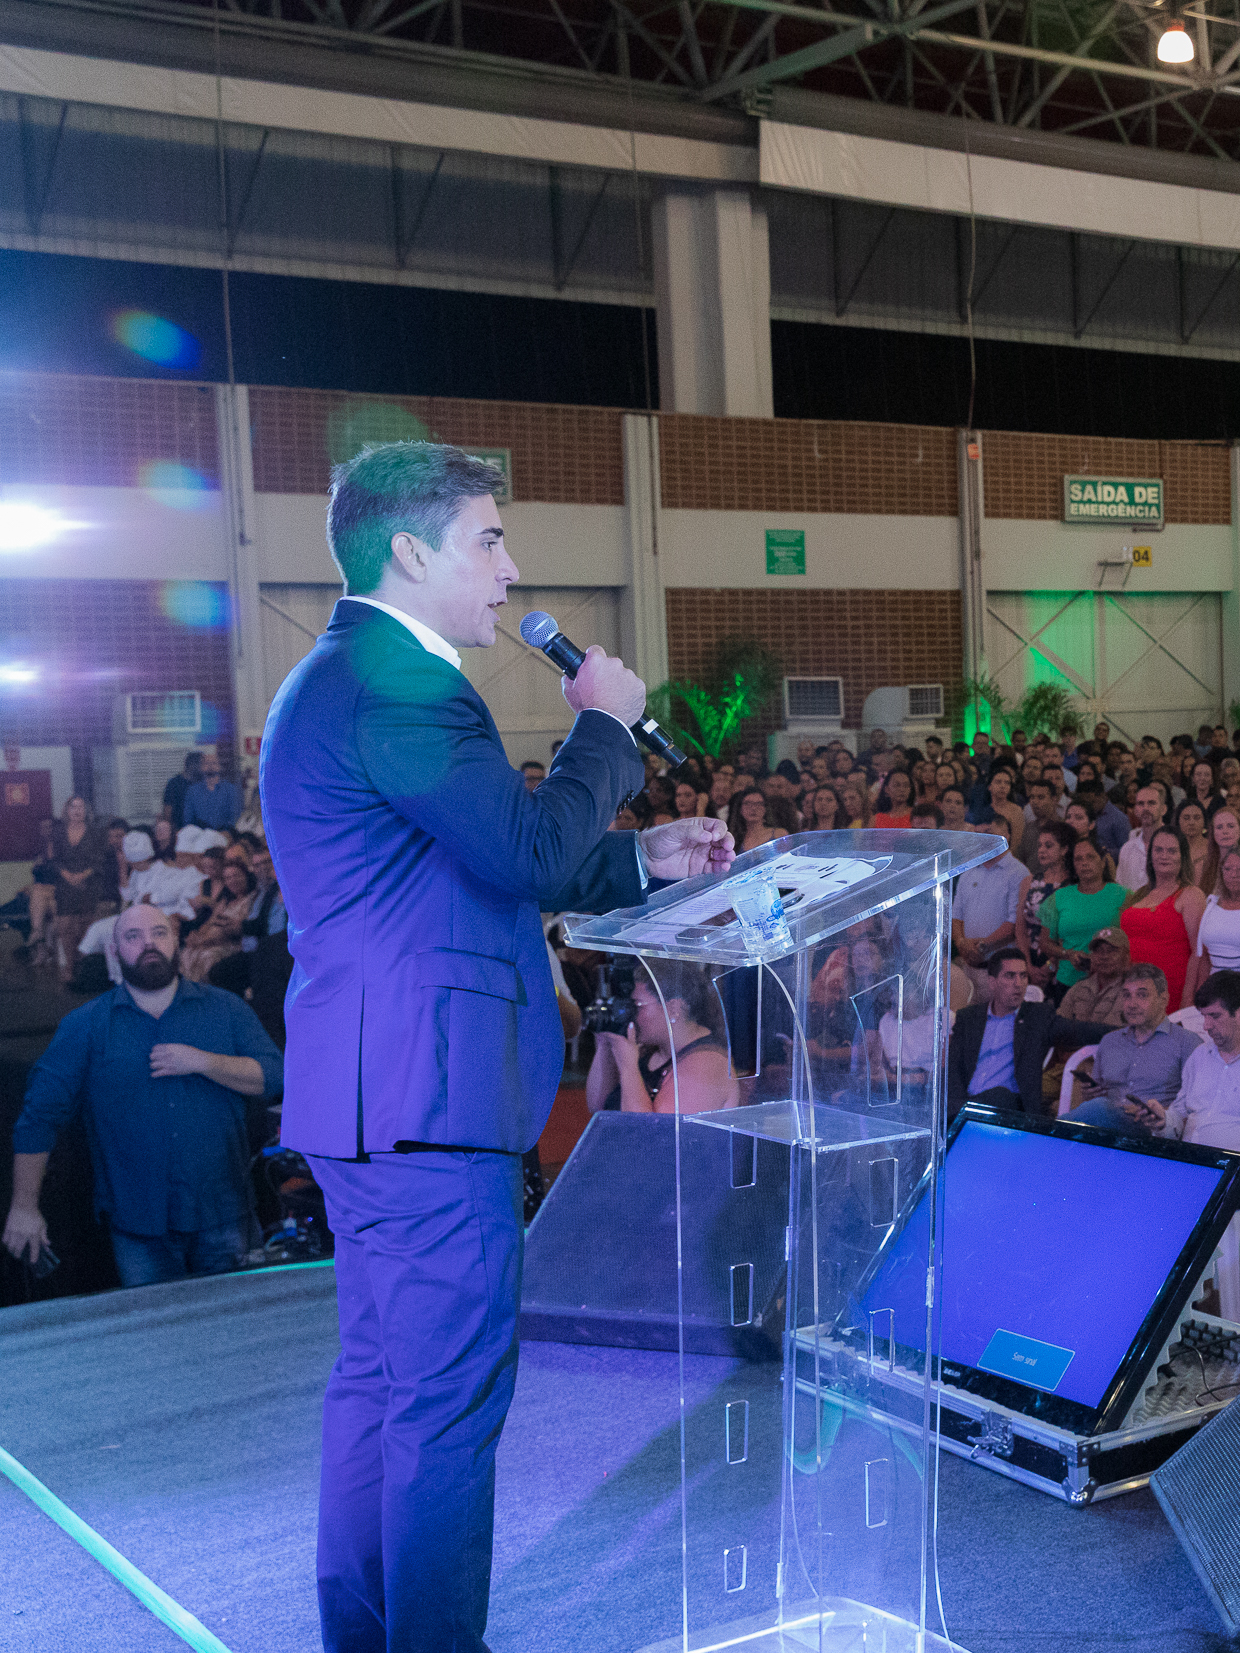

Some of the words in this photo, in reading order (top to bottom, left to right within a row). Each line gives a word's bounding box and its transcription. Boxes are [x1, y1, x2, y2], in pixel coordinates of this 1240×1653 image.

[1070, 481, 1129, 502] SAÍDA
[1133, 486, 1159, 504] DE
[1070, 502, 1159, 518] EMERGÊNCIA
[1133, 550, 1150, 562] 04
